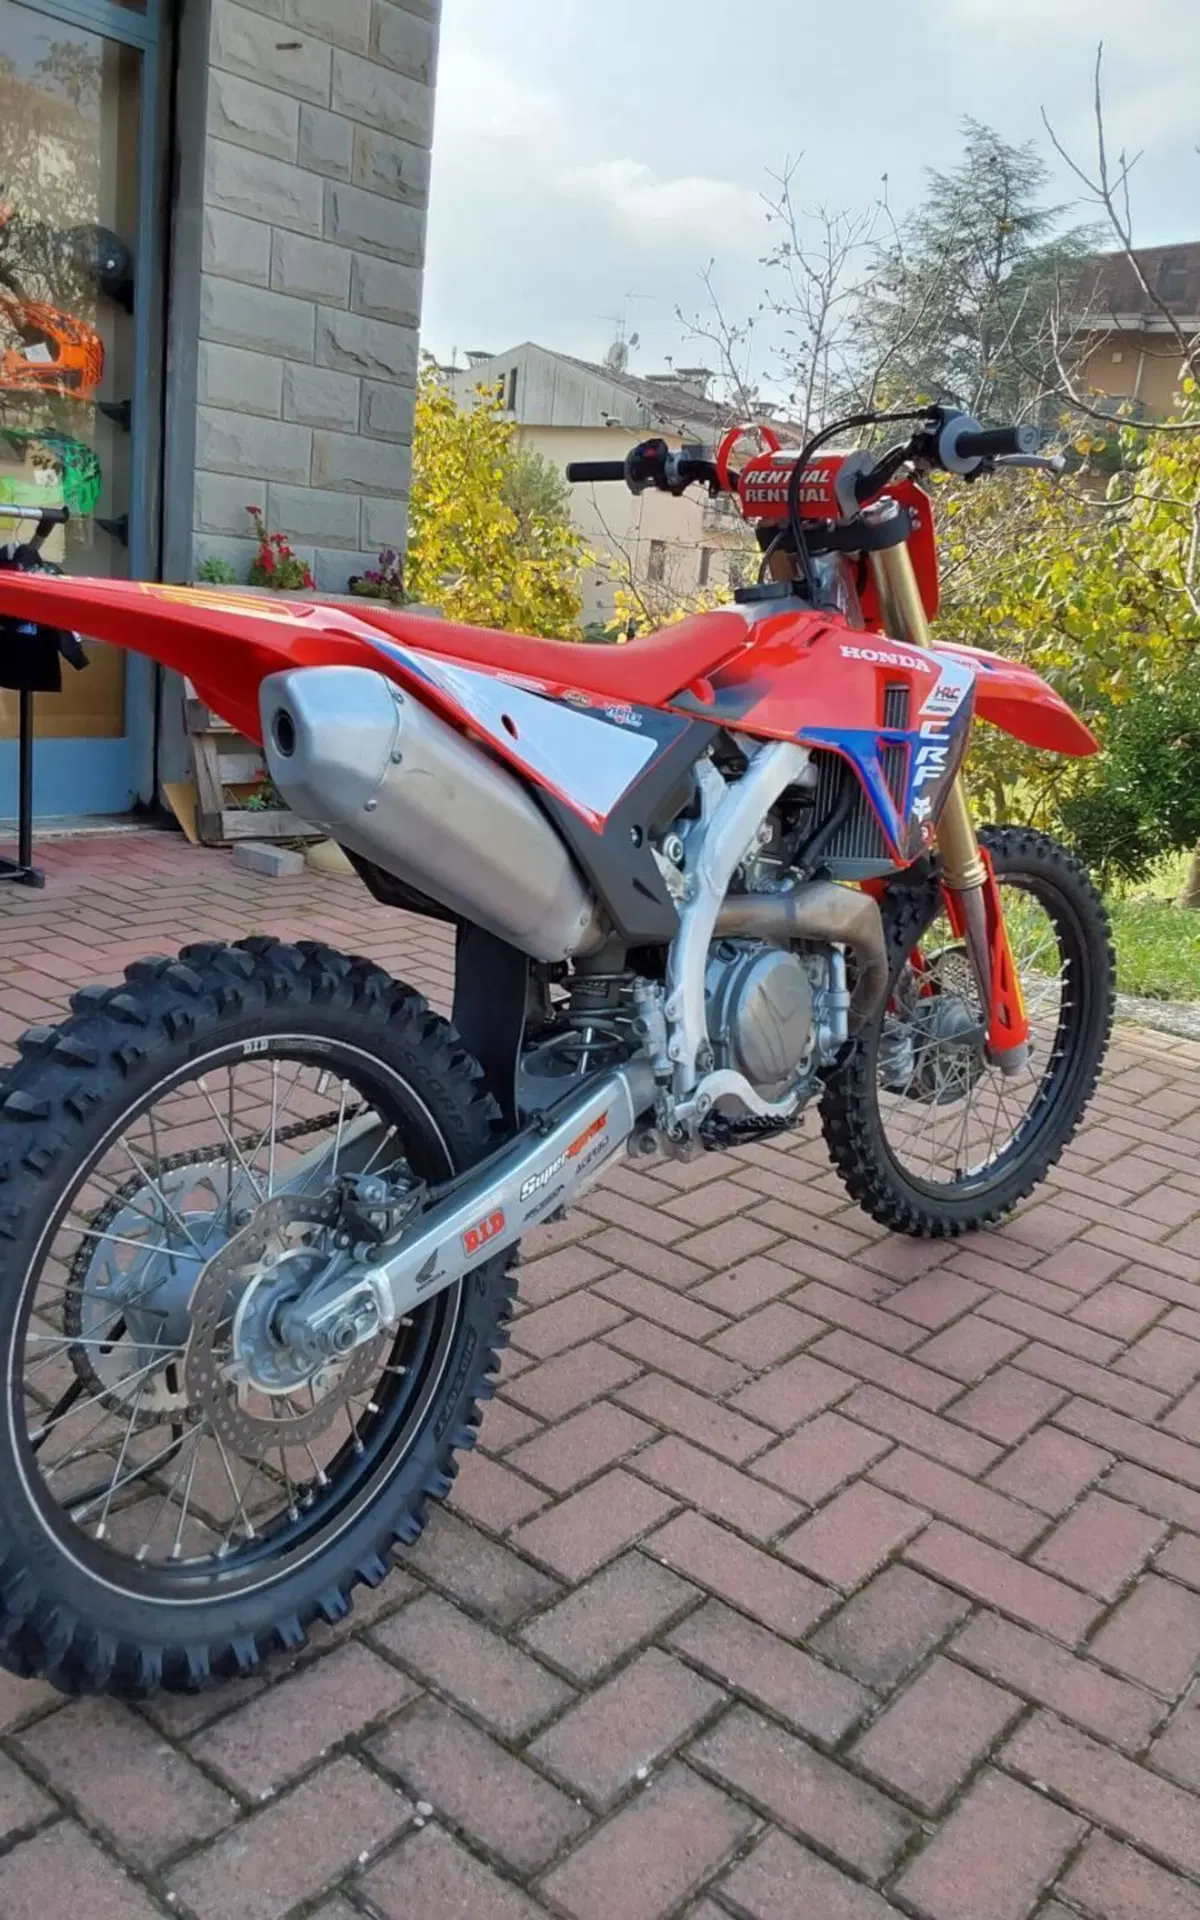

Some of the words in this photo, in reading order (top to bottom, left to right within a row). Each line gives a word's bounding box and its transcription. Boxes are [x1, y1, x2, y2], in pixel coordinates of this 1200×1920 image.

[839, 645, 932, 673] HONDA
[935, 685, 961, 699] HRC
[912, 720, 950, 787] CRF
